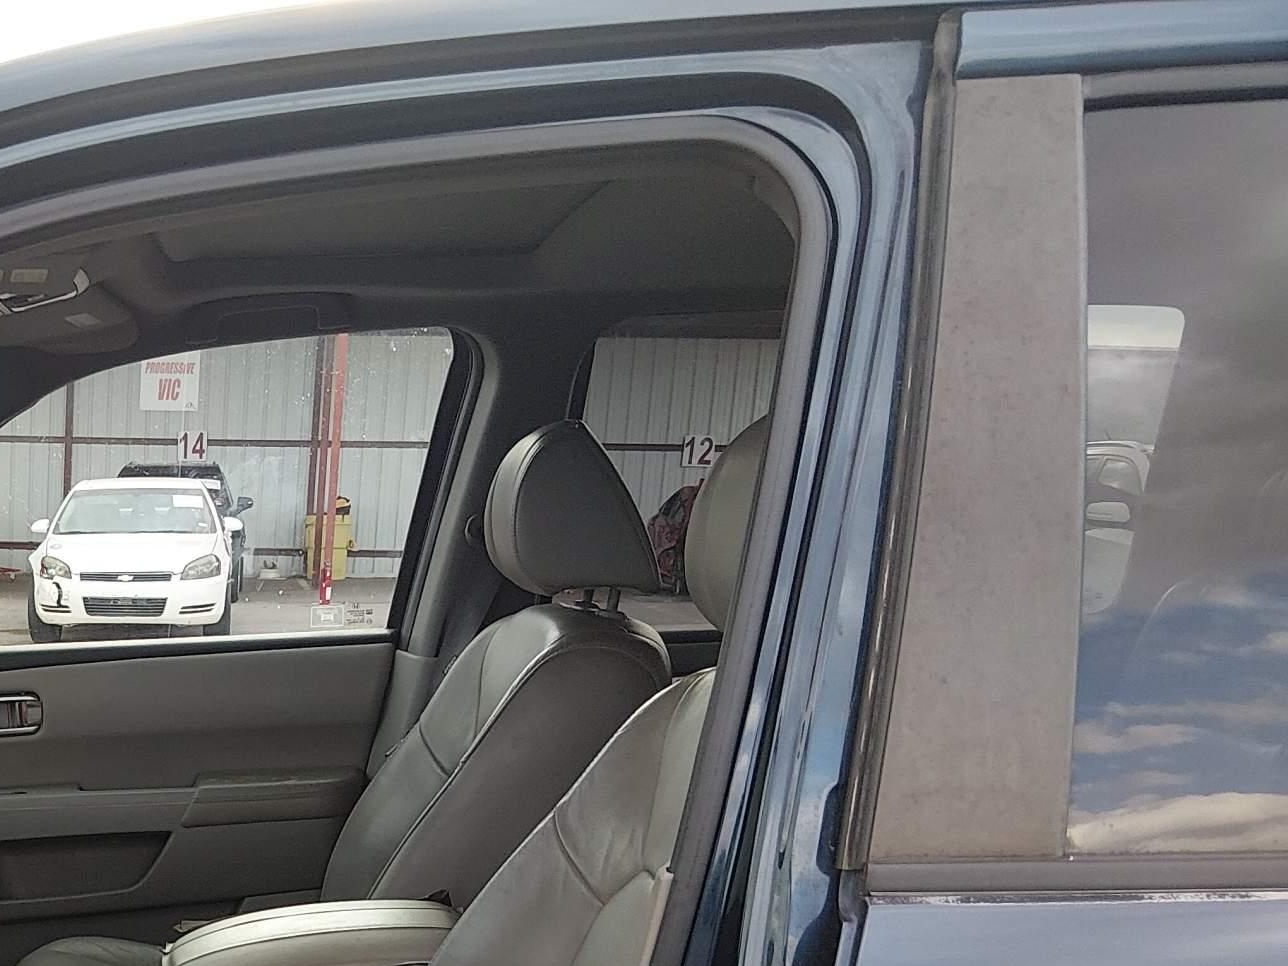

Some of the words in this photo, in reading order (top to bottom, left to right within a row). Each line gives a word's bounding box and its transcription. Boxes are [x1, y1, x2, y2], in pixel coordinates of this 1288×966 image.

[144, 361, 196, 375] PROGRESSIVE
[157, 378, 182, 401] VIC
[178, 431, 206, 460] 14
[684, 435, 714, 465] 12
